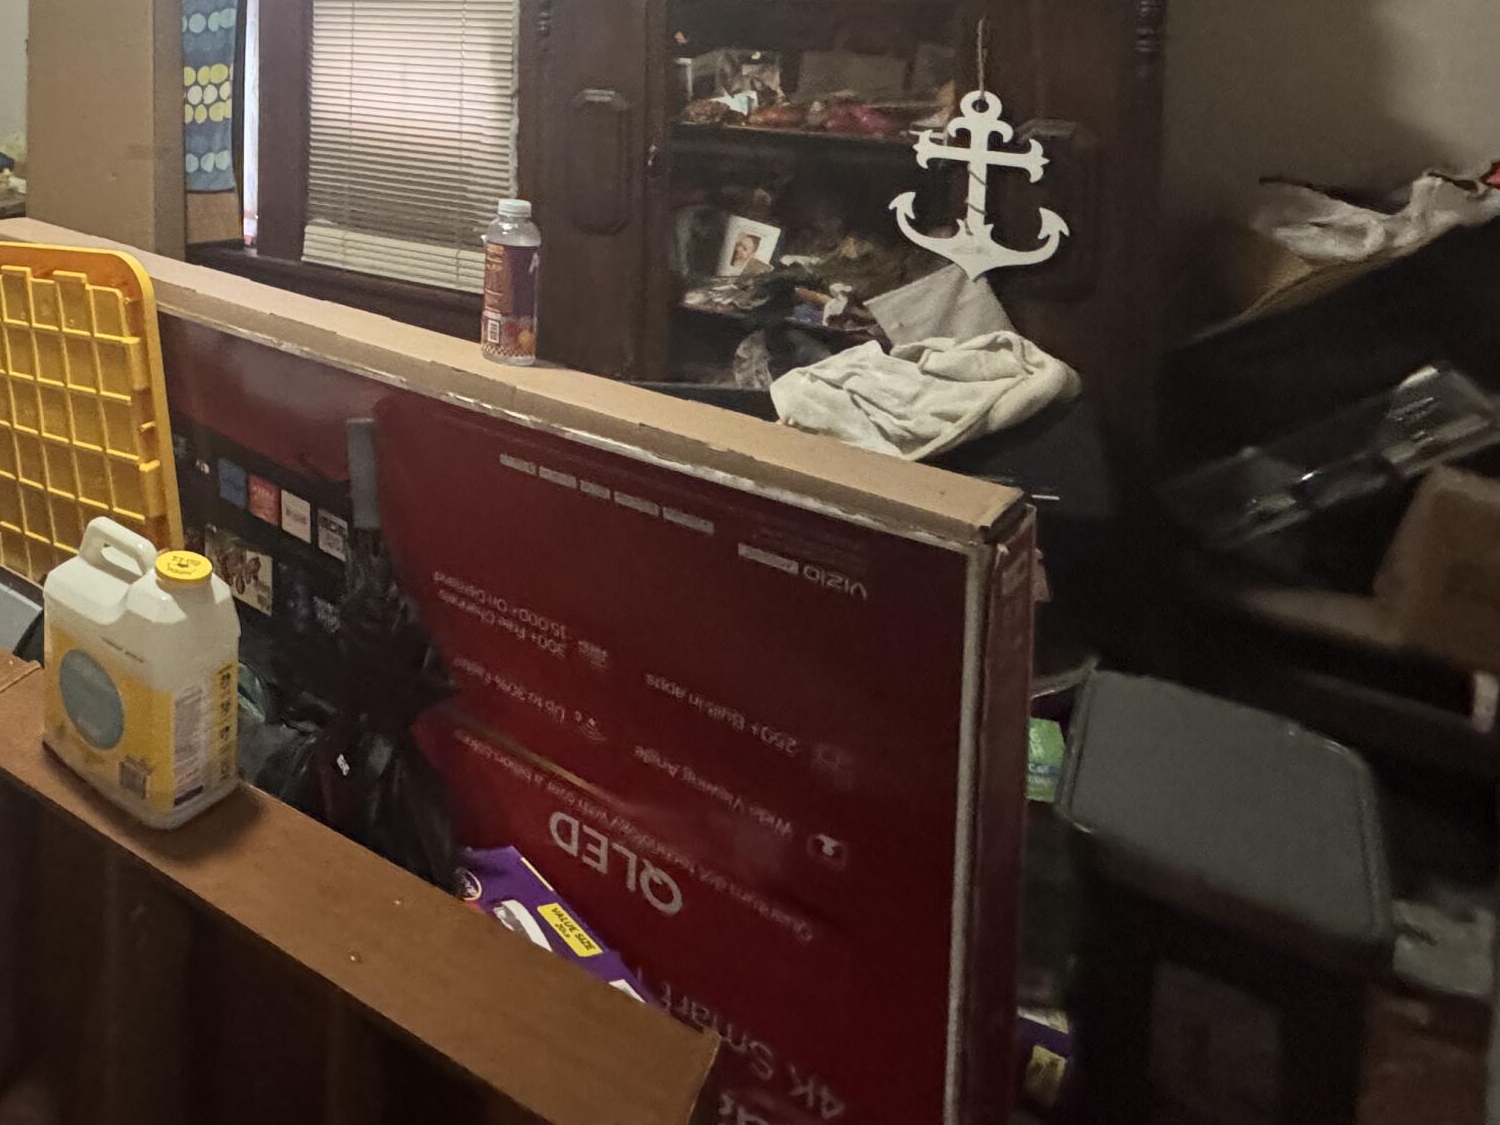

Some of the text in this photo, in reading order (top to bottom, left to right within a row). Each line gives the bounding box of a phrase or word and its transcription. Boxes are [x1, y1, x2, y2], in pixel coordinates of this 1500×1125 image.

[803, 564, 868, 601] VIZIO
[547, 810, 684, 918] QLED
[551, 907, 579, 933] VALUE
[787, 1062, 845, 1120] 4K
